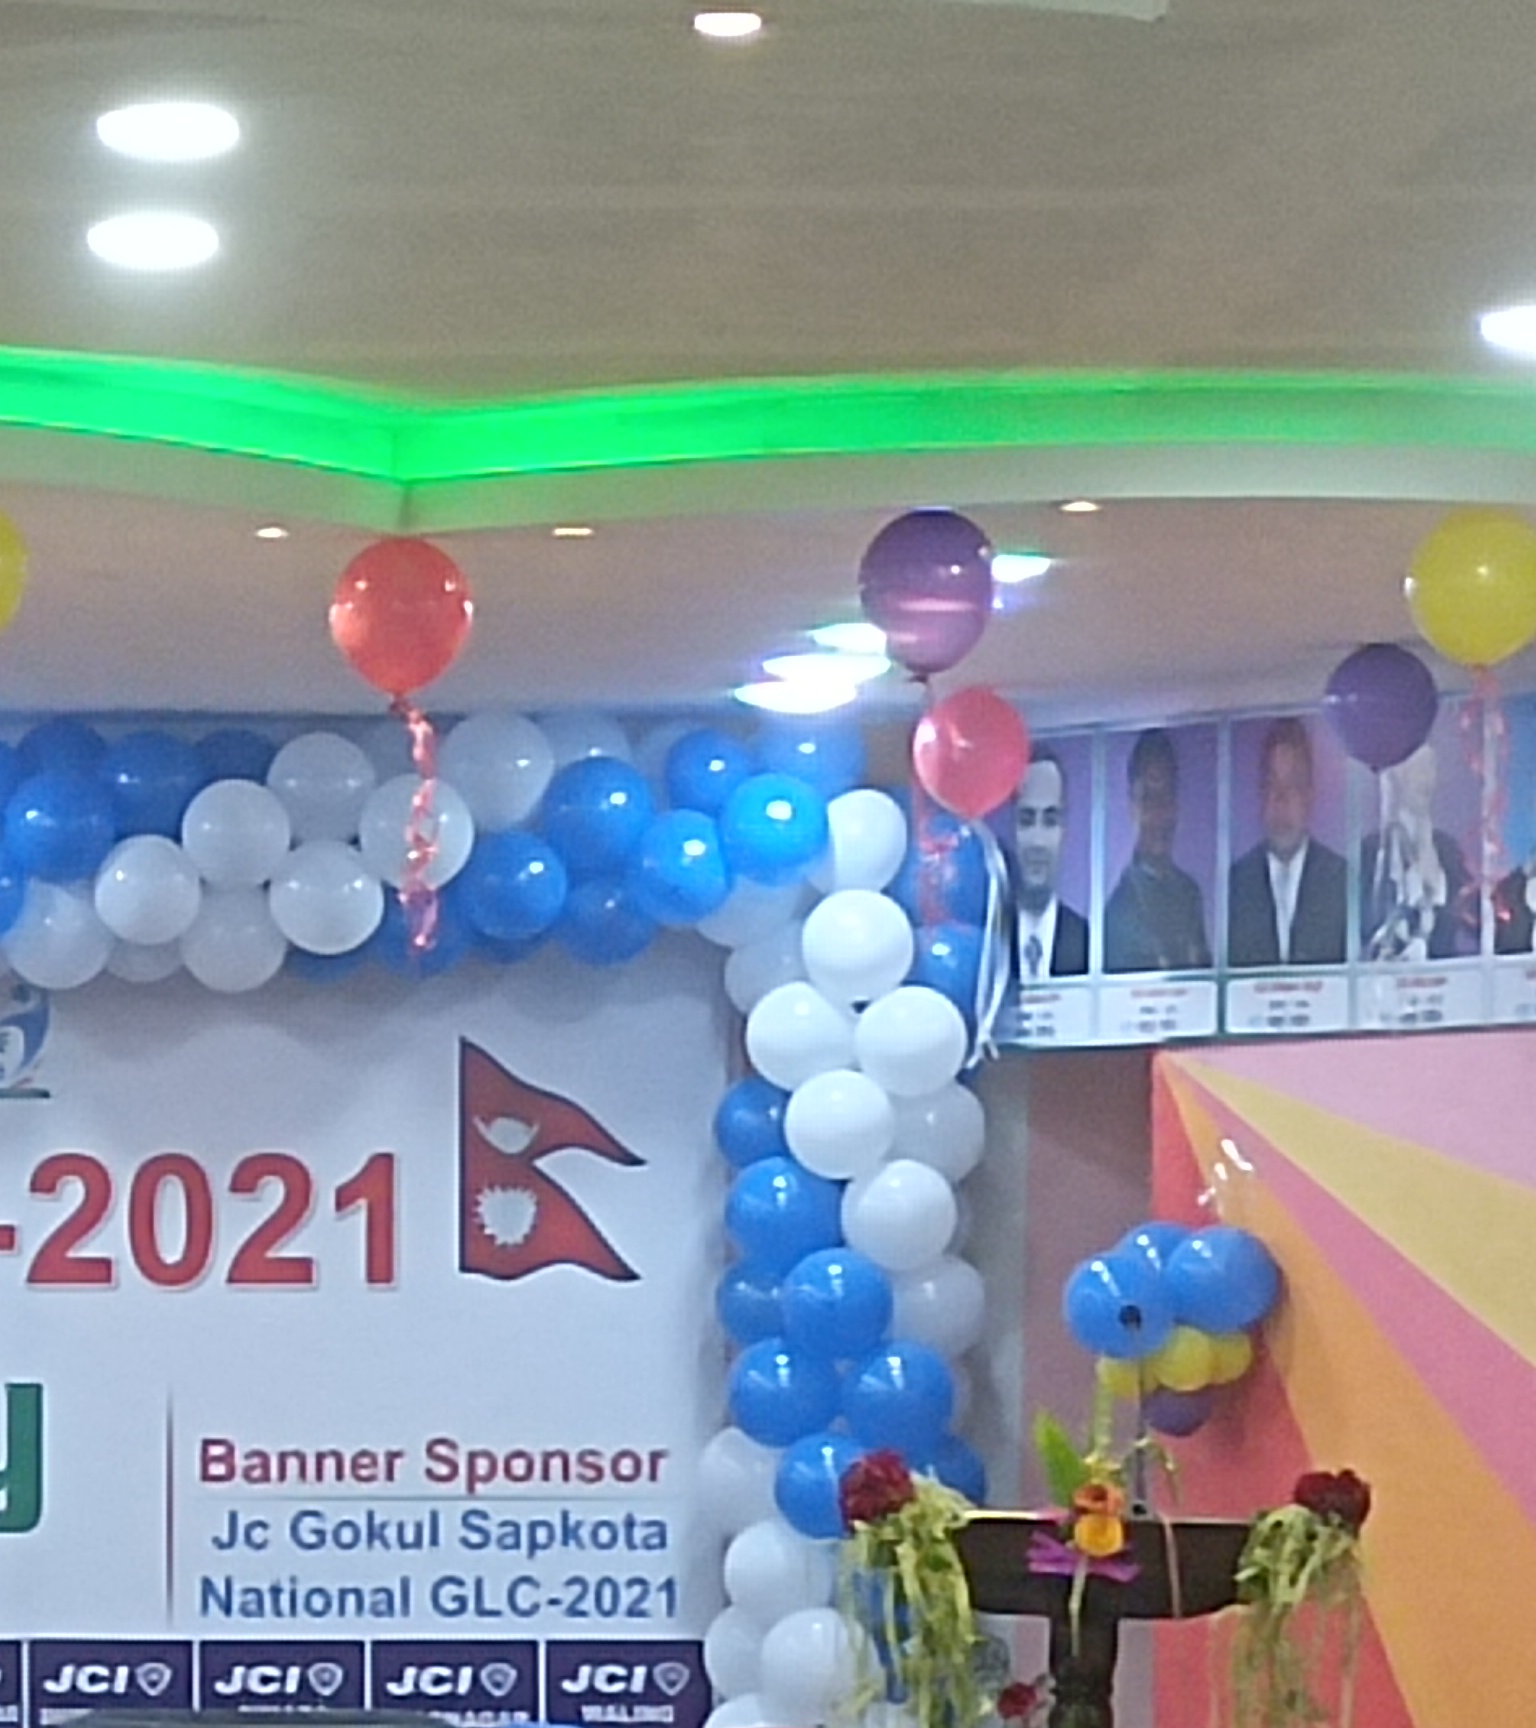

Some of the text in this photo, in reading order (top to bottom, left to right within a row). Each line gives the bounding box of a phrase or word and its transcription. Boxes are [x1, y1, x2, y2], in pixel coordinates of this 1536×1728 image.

[198, 1437, 670, 1494] Banner Sponsor
[210, 1508, 670, 1560] Jc Gokul Sapkota
[197, 1573, 679, 1620] National GLC-2021
[43, 1664, 130, 1694] JCI
[214, 1665, 301, 1695] JCI
[385, 1665, 473, 1696] JCI
[561, 1664, 647, 1694] JCI
